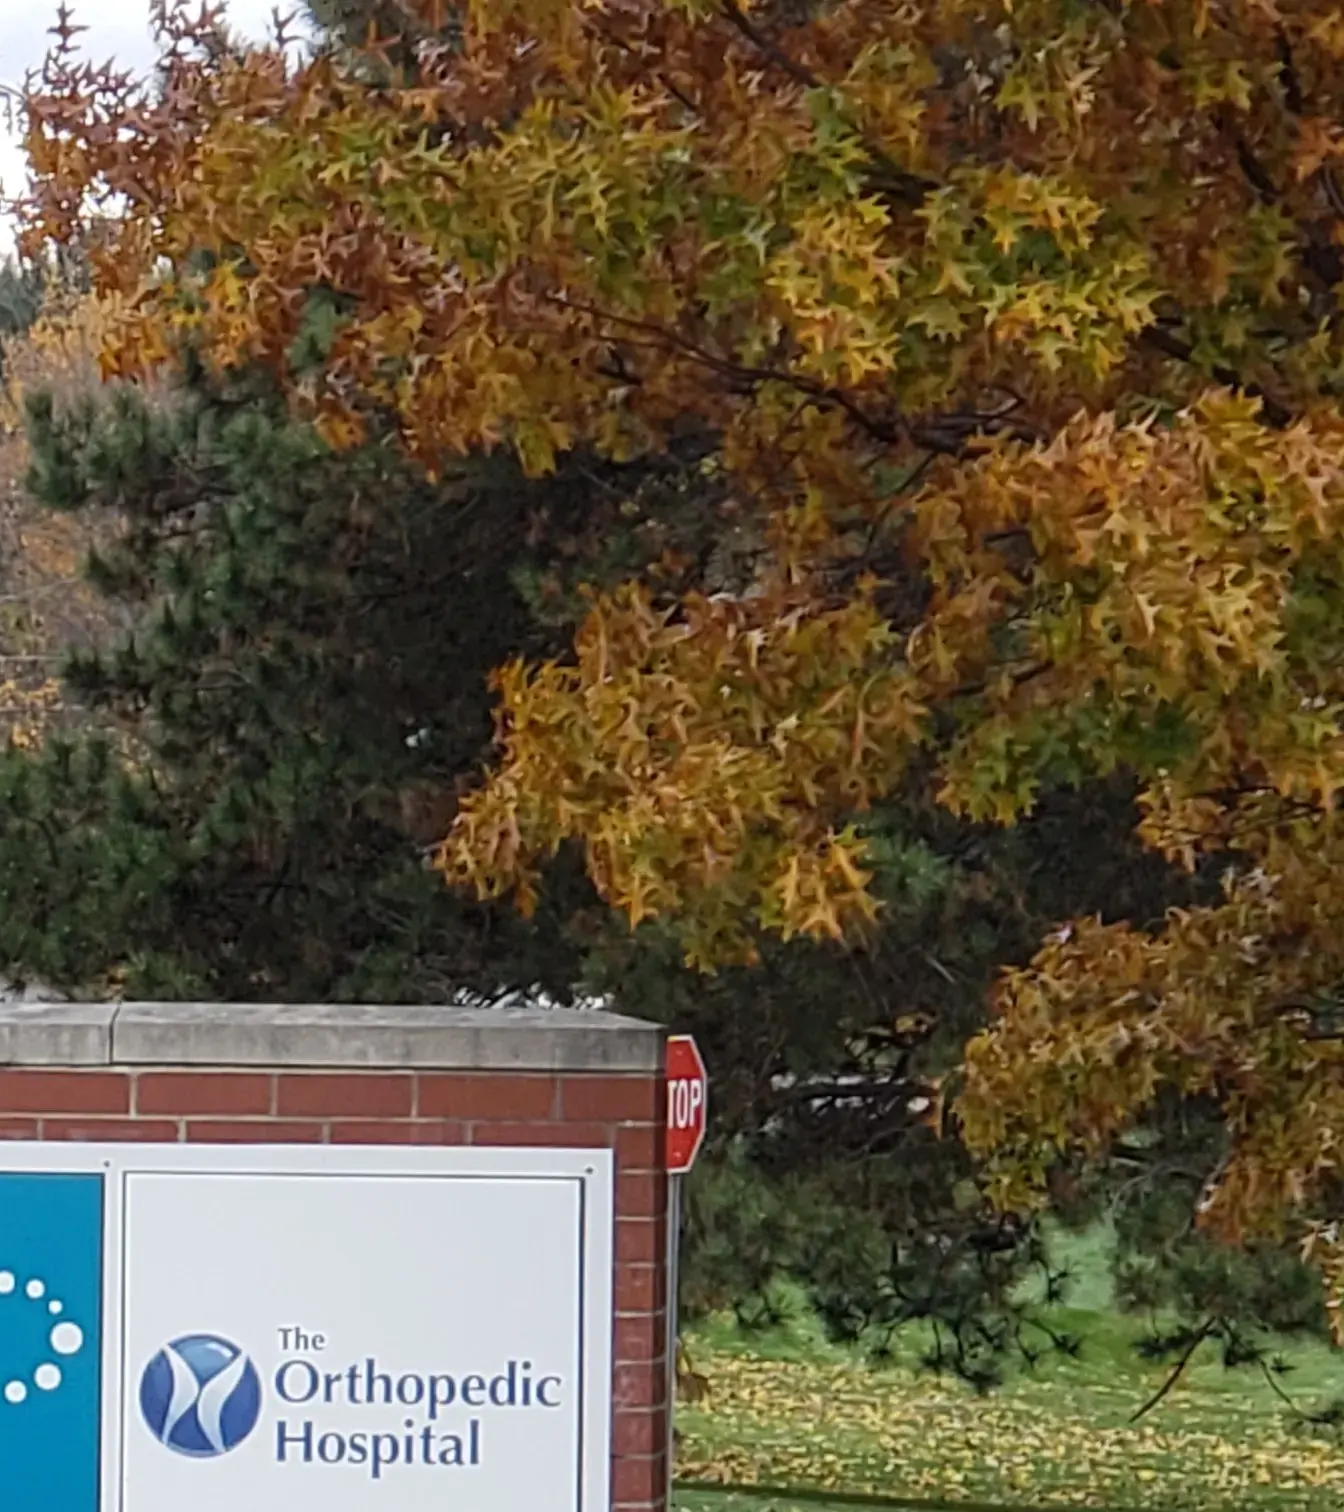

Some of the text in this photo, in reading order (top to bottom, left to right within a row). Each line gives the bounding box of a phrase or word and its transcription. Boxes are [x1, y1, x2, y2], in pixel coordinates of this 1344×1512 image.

[667, 1078, 702, 1129] TOP
[278, 1326, 326, 1351] The
[274, 1358, 562, 1419] Orthopedic
[276, 1418, 480, 1479] Hospital
